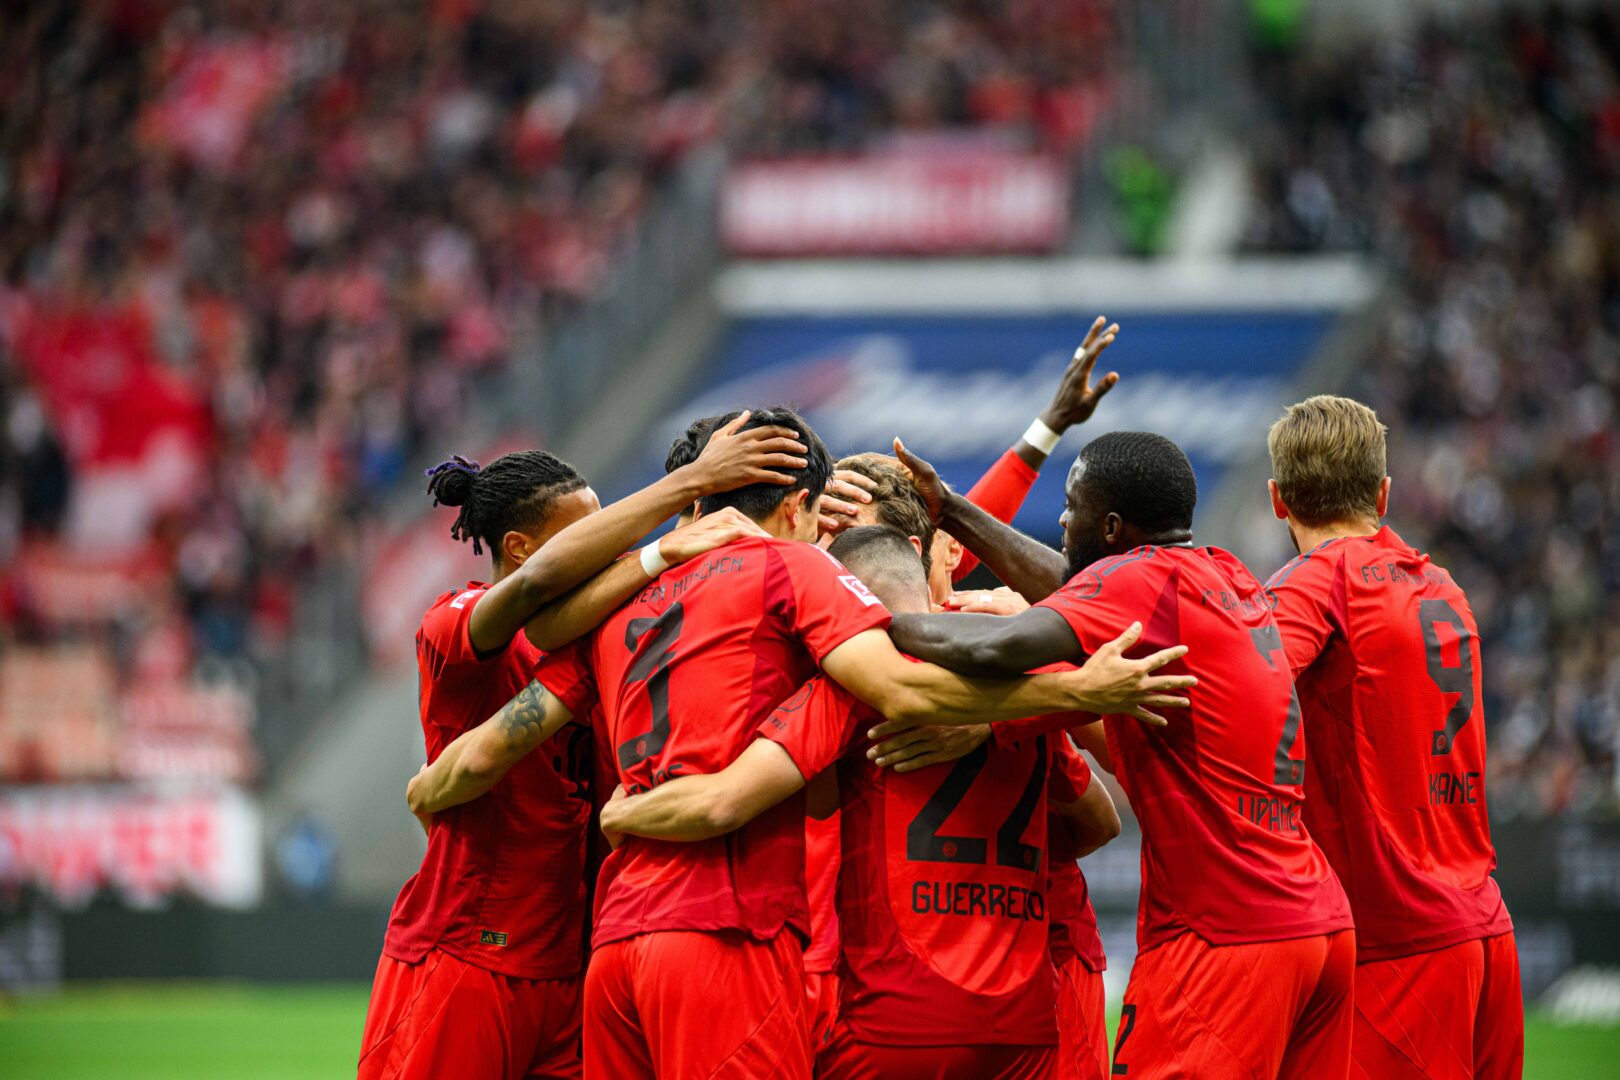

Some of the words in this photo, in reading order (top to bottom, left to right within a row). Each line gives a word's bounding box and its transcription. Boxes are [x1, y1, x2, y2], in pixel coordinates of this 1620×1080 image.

[1362, 566, 1385, 584] FC
[1418, 599, 1474, 756] 9
[1429, 771, 1480, 805] KANE
[1111, 1004, 1137, 1075] 2
